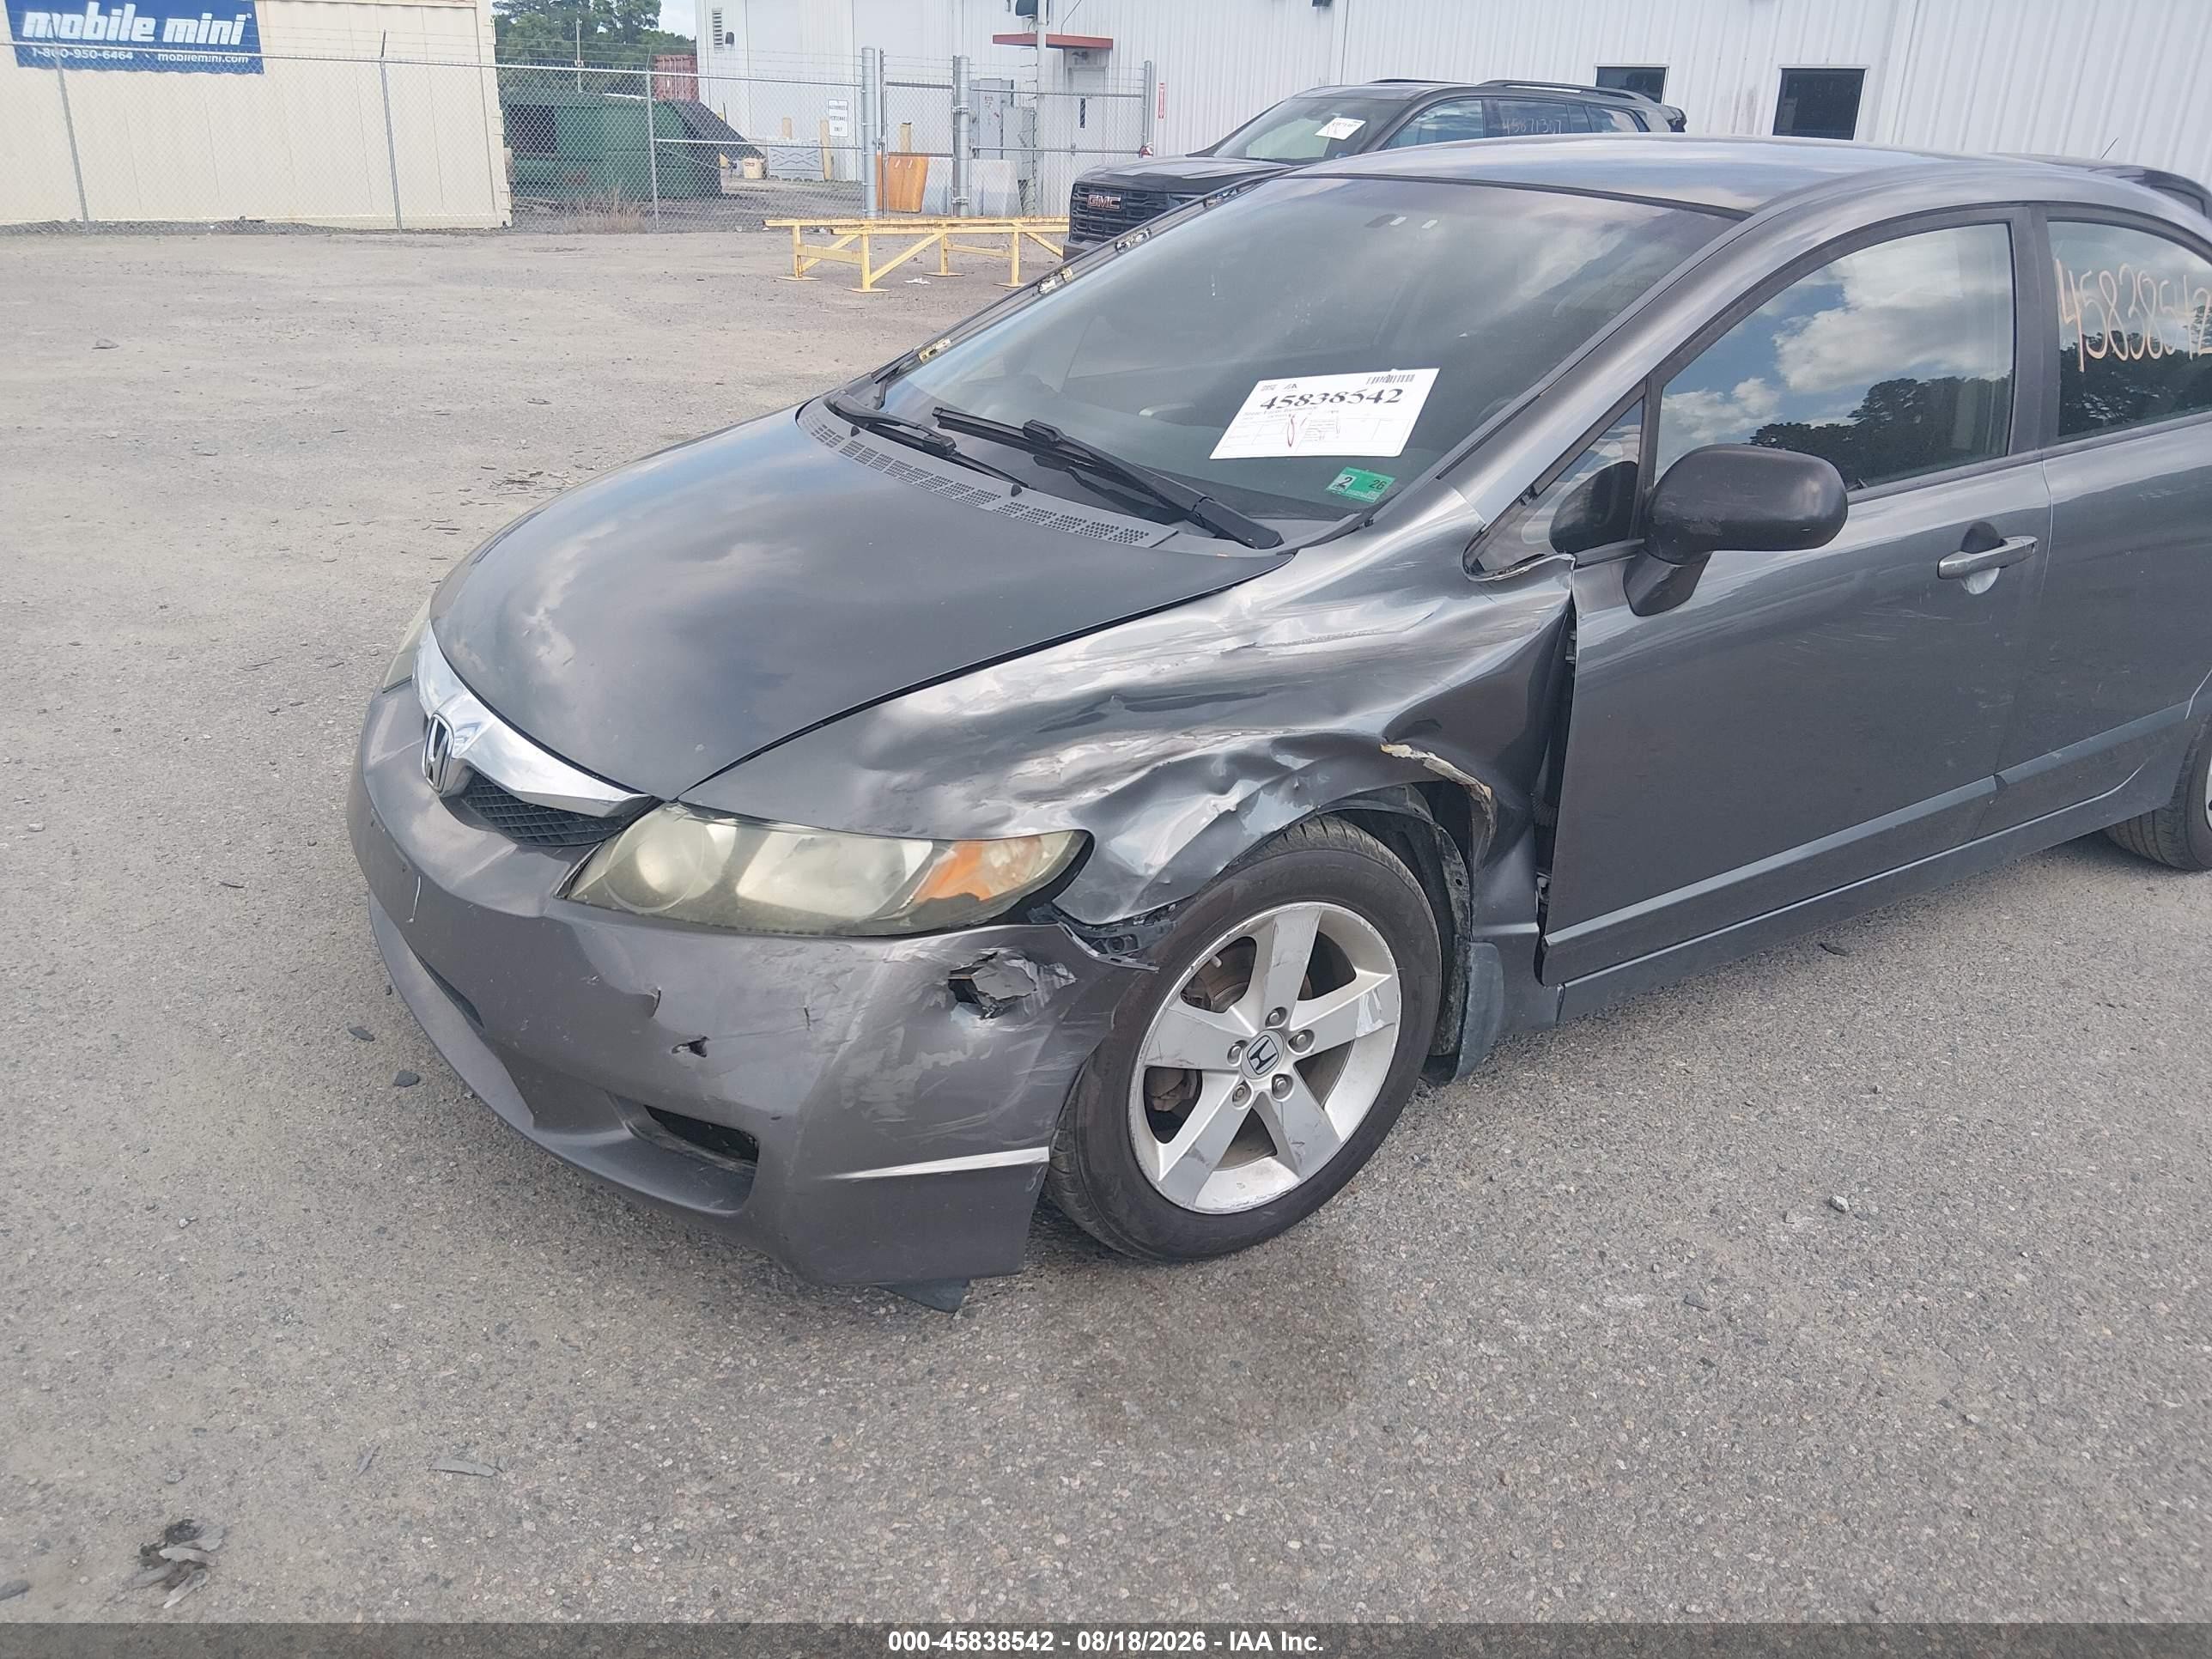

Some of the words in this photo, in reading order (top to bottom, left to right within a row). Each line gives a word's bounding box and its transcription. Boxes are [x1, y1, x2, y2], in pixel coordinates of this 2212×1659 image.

[22, 2, 155, 42] mobile
[162, 13, 246, 45] mini
[1088, 194, 1121, 210] GMC
[1260, 388, 1404, 410] 45838542
